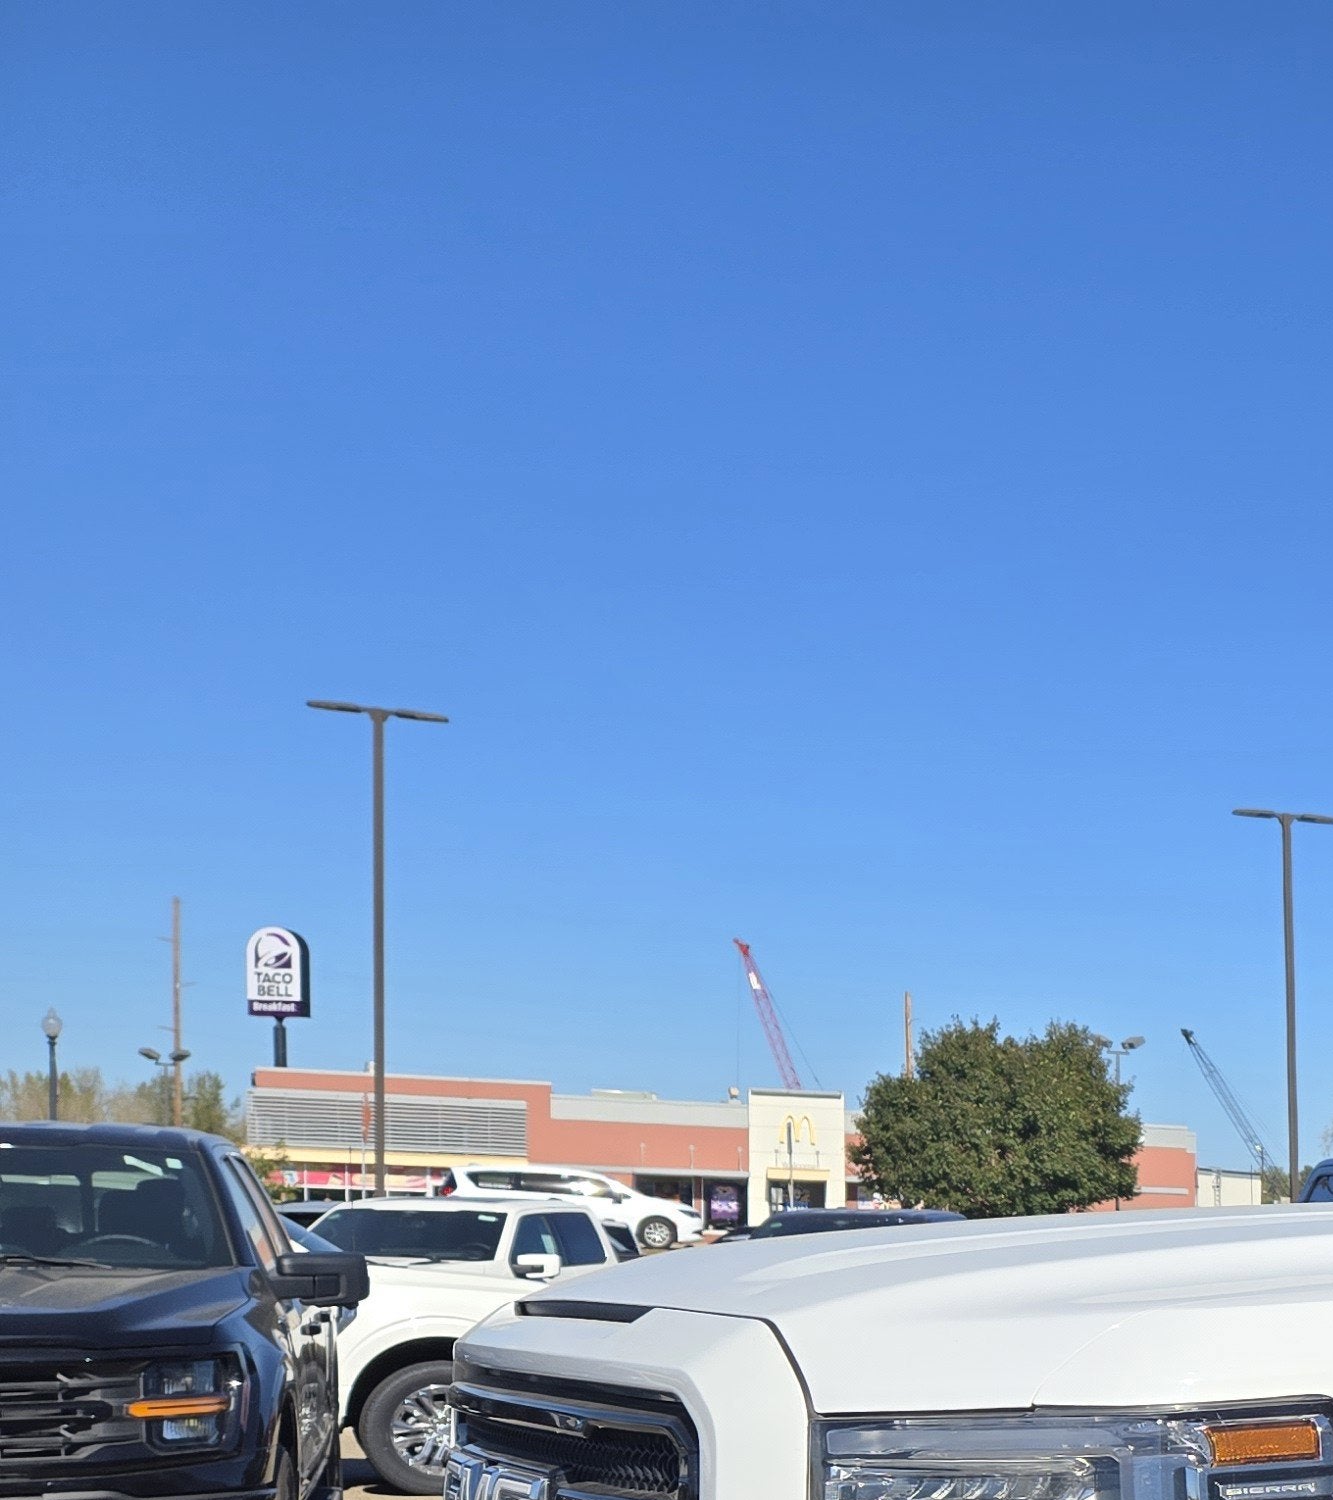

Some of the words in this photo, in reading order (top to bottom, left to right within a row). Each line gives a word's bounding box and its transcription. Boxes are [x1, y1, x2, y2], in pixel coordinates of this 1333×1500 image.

[254, 971, 293, 984] TACO
[257, 985, 293, 997] BELL
[1225, 1482, 1317, 1496] SIERRA
